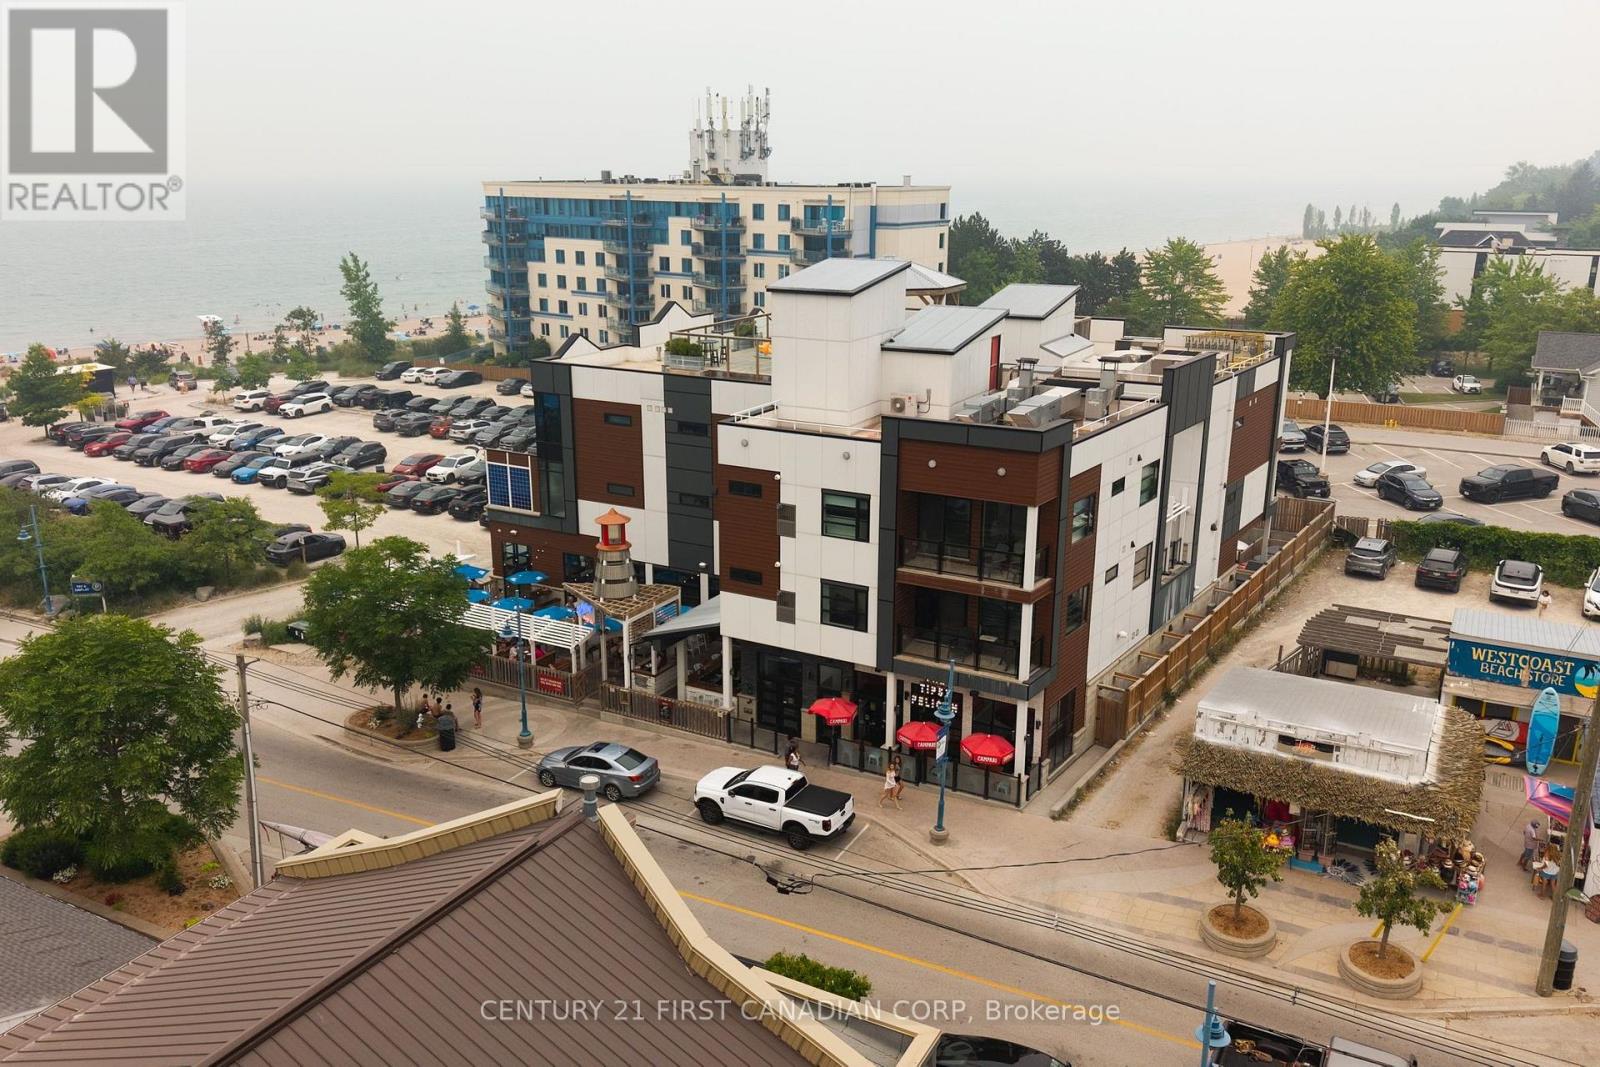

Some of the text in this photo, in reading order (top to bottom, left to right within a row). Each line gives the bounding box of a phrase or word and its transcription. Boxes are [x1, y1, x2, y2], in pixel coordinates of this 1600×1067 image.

[1471, 646, 1575, 675] WESTCOAST
[1480, 662, 1566, 687] BEACH STORE
[911, 694, 958, 713] PELICN
